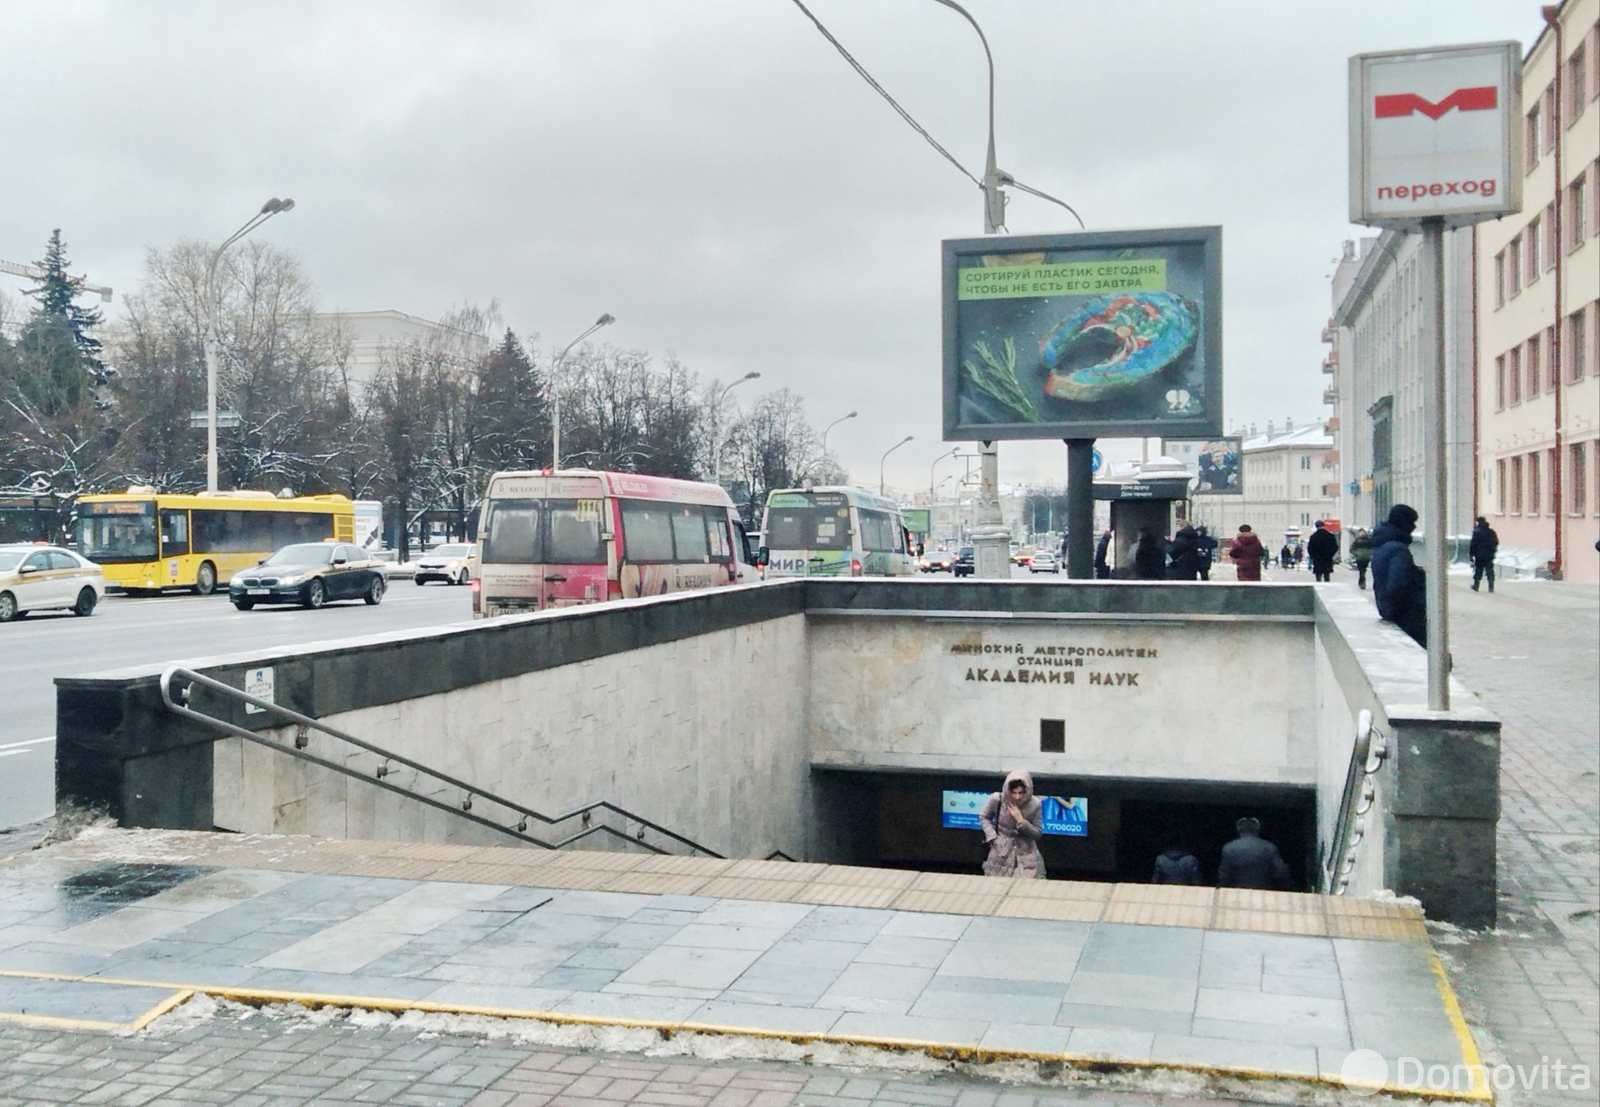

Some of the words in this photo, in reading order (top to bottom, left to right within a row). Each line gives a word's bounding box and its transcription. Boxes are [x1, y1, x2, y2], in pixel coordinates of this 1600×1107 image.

[1377, 178, 1497, 202] переход
[965, 269, 1031, 284] СОРТИРУЙ
[1034, 266, 1093, 280] ПЛАСТИК
[1097, 264, 1160, 278] СЕГОДНЯ,
[965, 284, 1009, 295] ЧТОБЫ
[1012, 283, 1028, 293] НЕ
[1032, 281, 1064, 292] ЕСТЬ
[1066, 280, 1091, 291] ЕГО
[1094, 278, 1144, 290] ЗАВТРА
[769, 558, 805, 571] МИР
[1033, 646, 1158, 658] МЕТРОПОЛИТЕН
[1017, 656, 1084, 667] СТАНЦИЯ
[965, 667, 1075, 685] АКАДЕМИЯ
[1089, 672, 1140, 687] НАУК
[1046, 822, 1082, 833] 7708020
